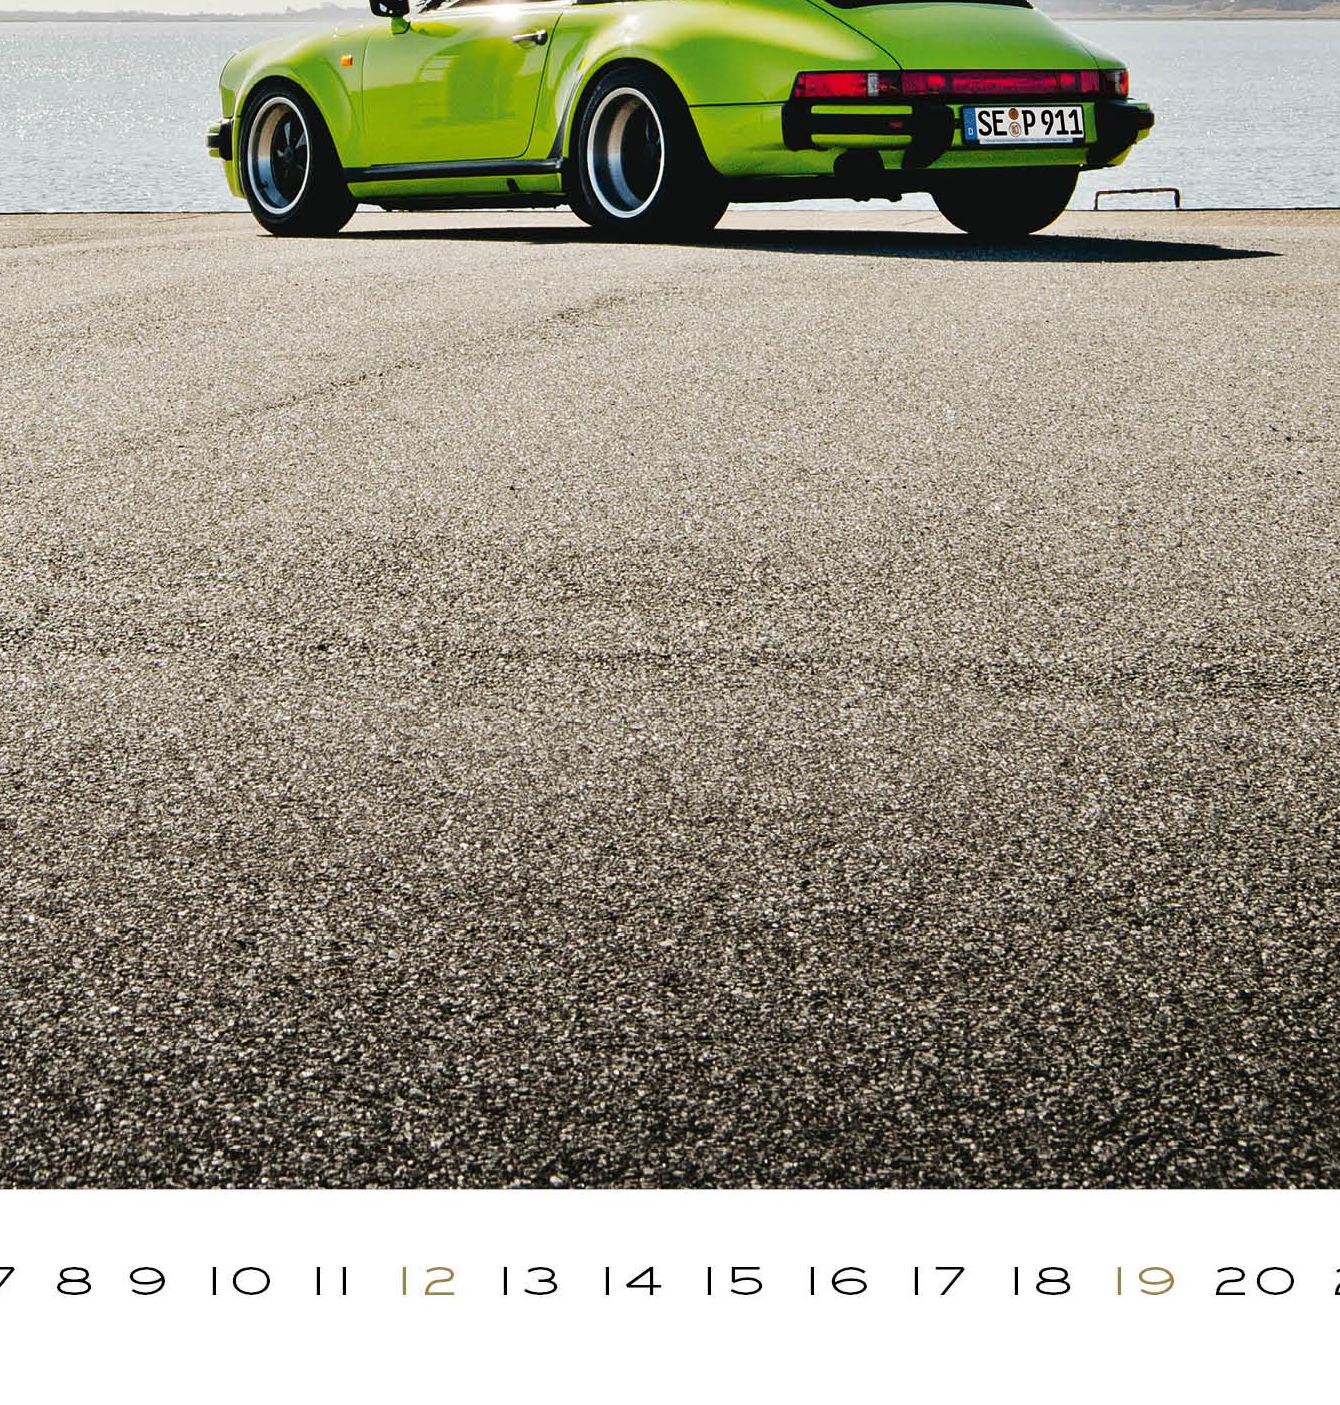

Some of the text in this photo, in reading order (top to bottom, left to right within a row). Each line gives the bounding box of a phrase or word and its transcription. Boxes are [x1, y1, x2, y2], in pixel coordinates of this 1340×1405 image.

[977, 109, 1083, 136] SE P 911
